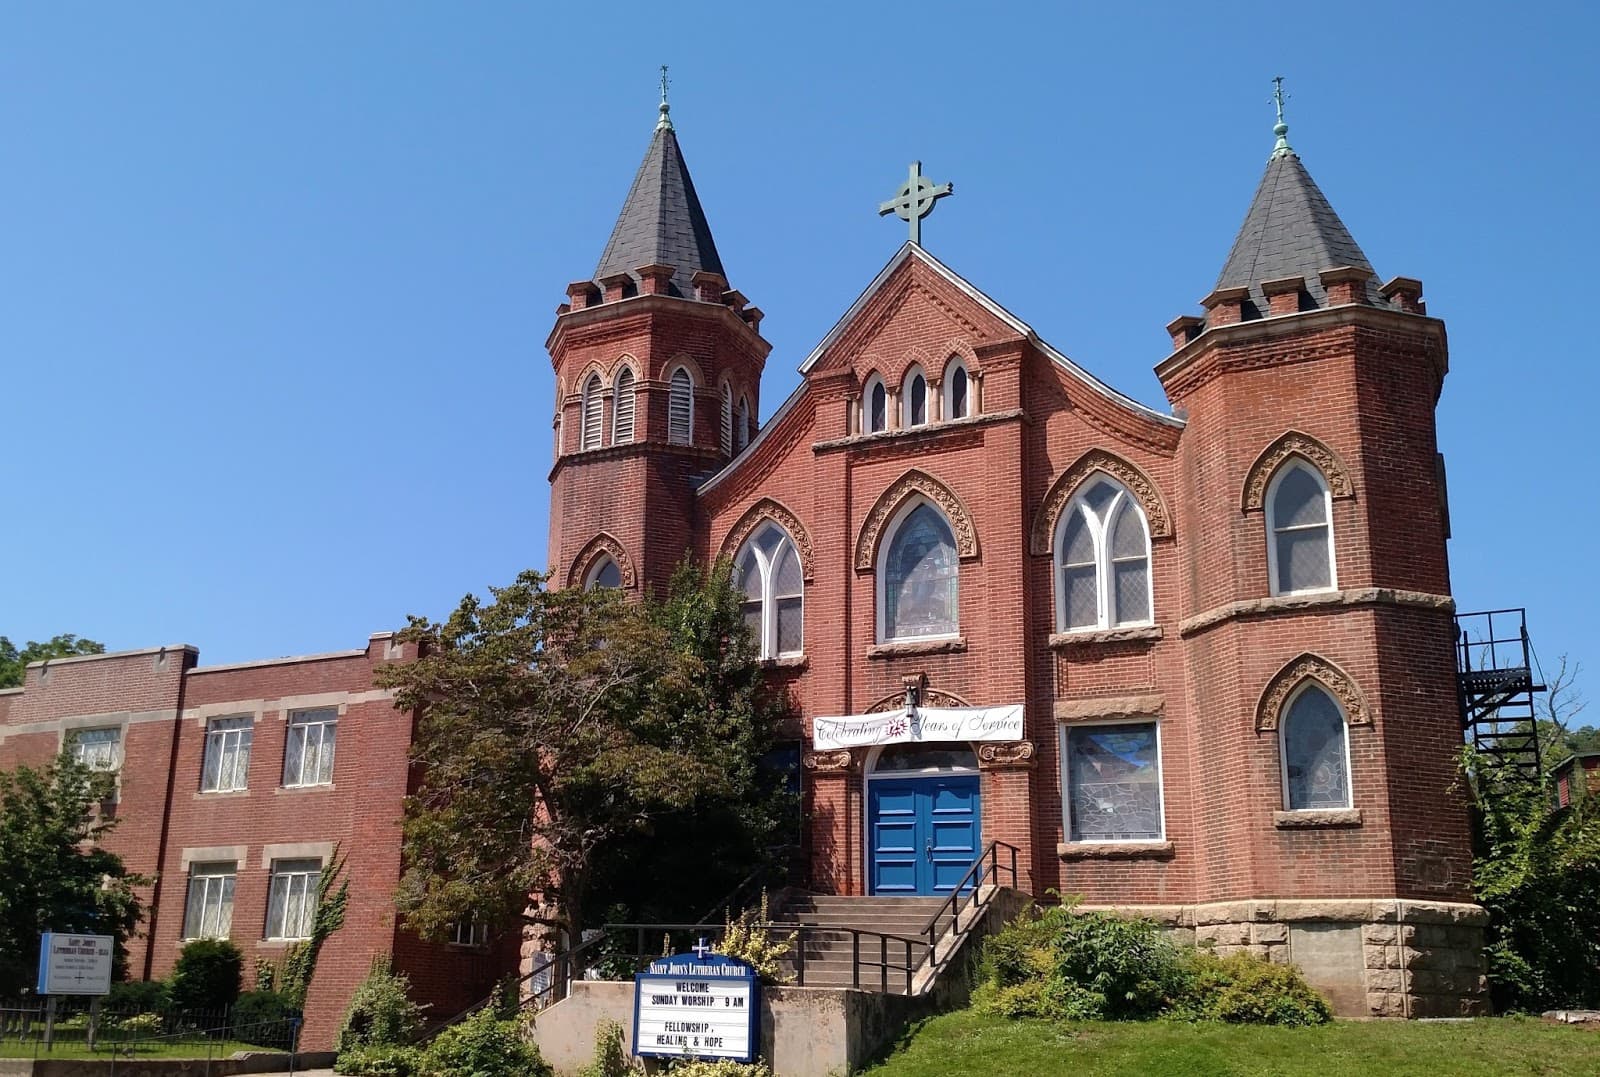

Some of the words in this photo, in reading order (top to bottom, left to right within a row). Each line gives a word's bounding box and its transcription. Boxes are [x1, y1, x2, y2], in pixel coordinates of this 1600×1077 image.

[816, 718, 881, 743] Celebrating
[910, 713, 948, 736] Years
[952, 713, 967, 739] of
[968, 711, 1020, 730] Service
[650, 961, 668, 975] SAINT
[668, 962, 688, 975] JOHN'S
[689, 962, 720, 976] LUTHERAN
[721, 963, 746, 977] CHURCH
[676, 982, 709, 993] WELCOME
[652, 995, 678, 1006] SUNDAY
[681, 996, 715, 1007] WORSHIP
[725, 997, 730, 1007] 9
[732, 997, 744, 1008] AM
[656, 1035, 688, 1046] HEALING
[693, 1036, 699, 1047] &
[704, 1037, 723, 1048] HOPE
